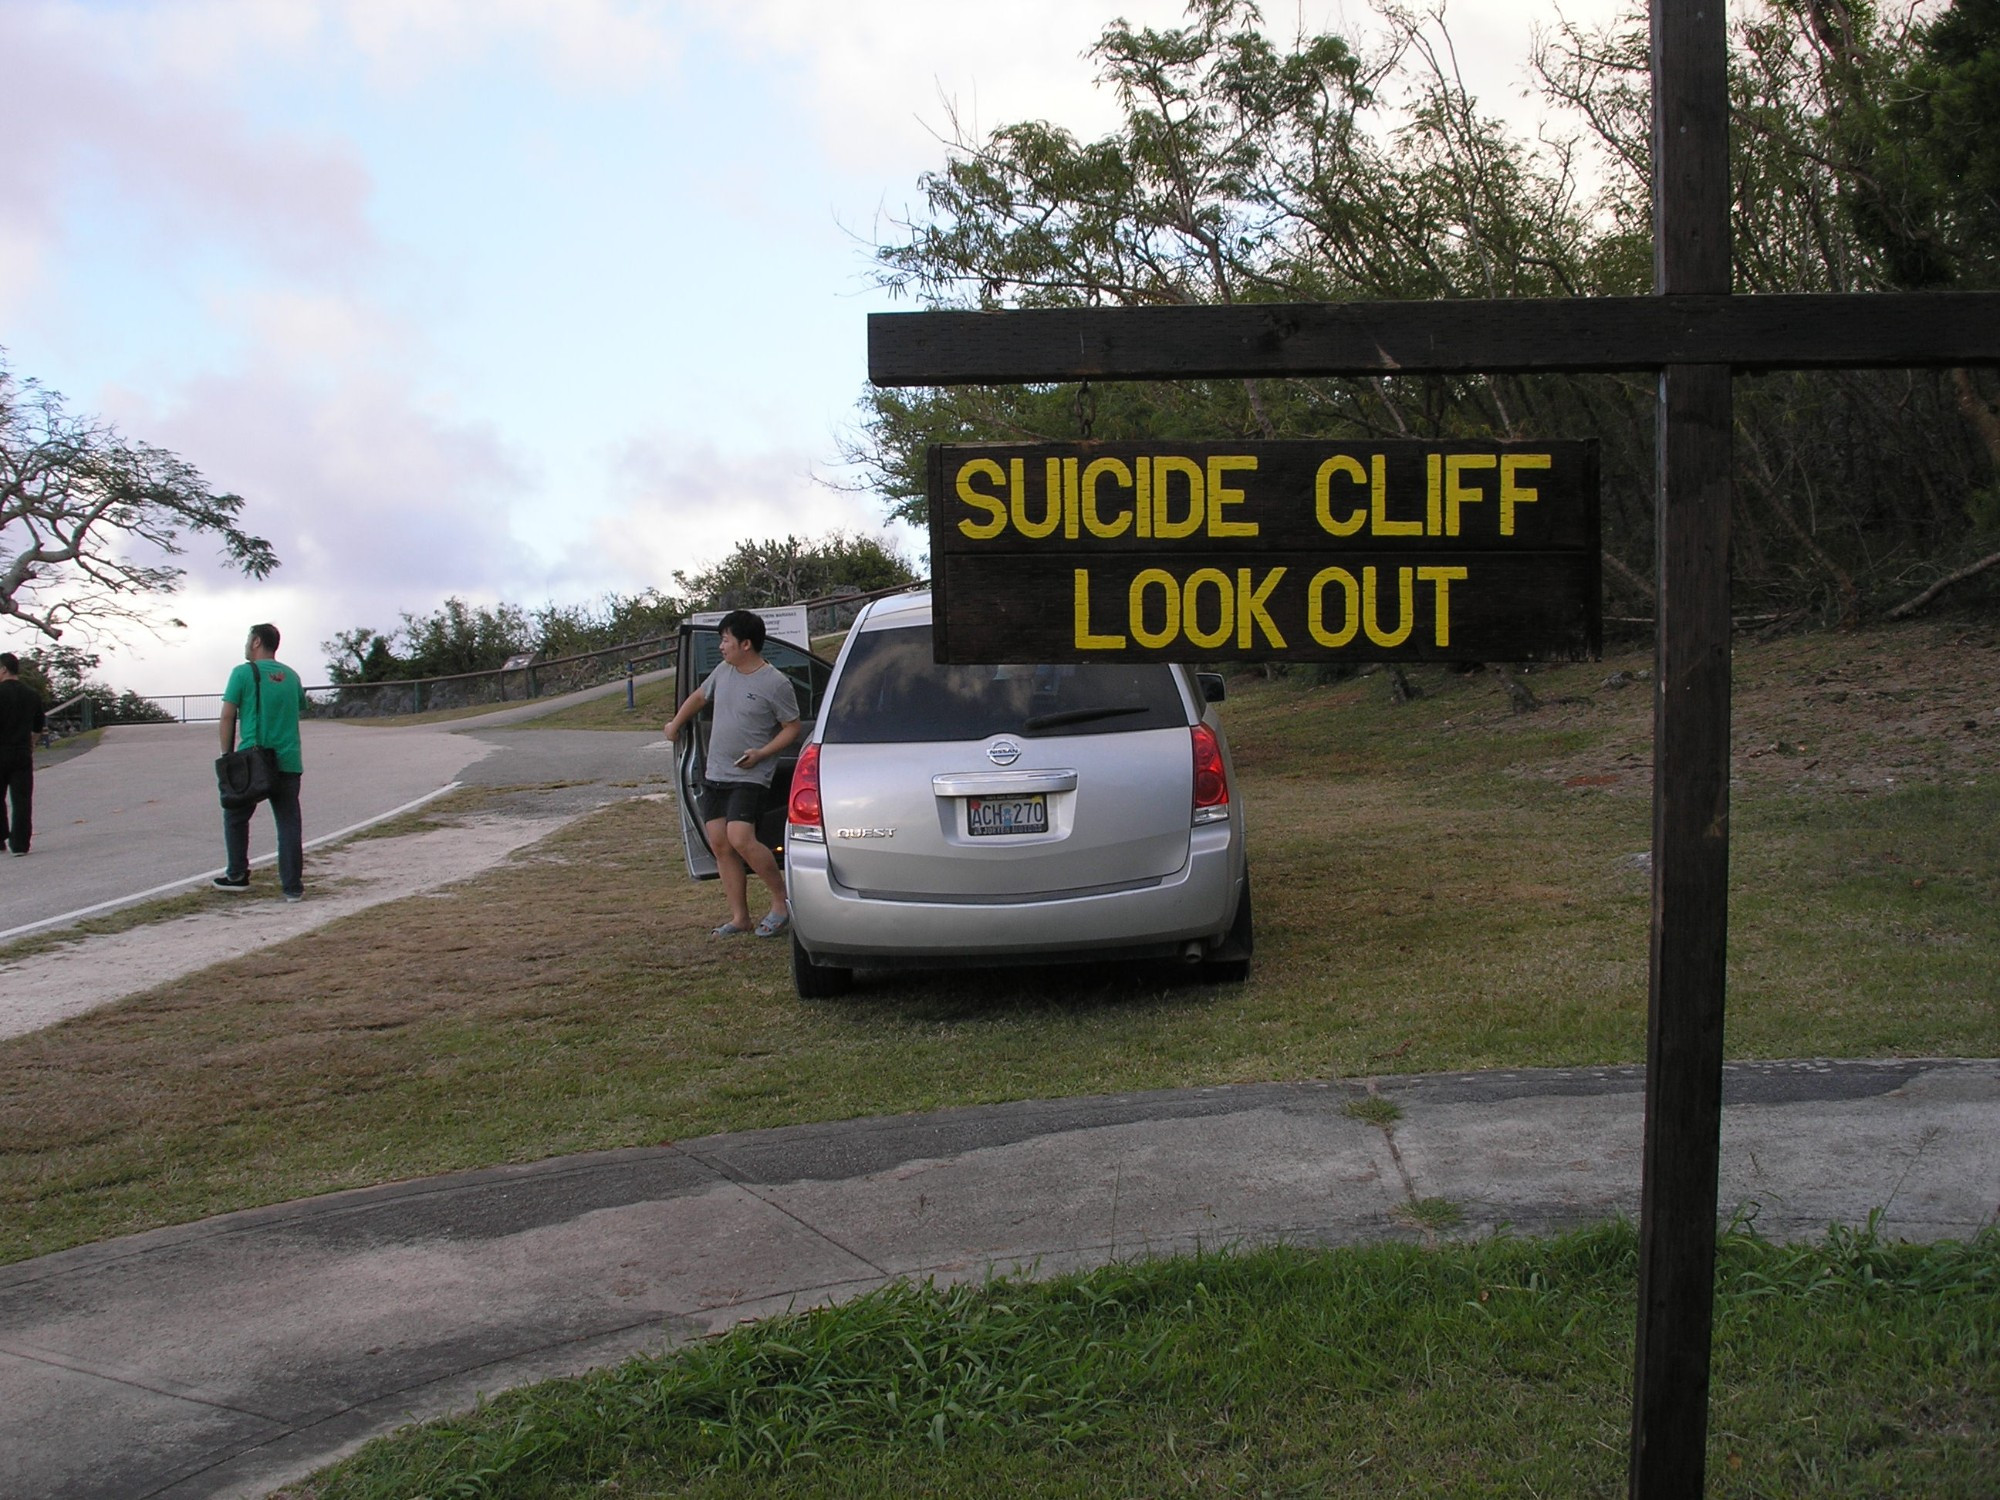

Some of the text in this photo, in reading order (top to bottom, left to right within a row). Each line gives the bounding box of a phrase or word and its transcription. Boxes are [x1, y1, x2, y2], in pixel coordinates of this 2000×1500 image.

[957, 454, 1550, 538] SUICIDE CLIFF
[1075, 567, 1467, 648] LOOK OUT
[837, 827, 897, 840] QUEST
[972, 802, 1044, 826] ACH 270
